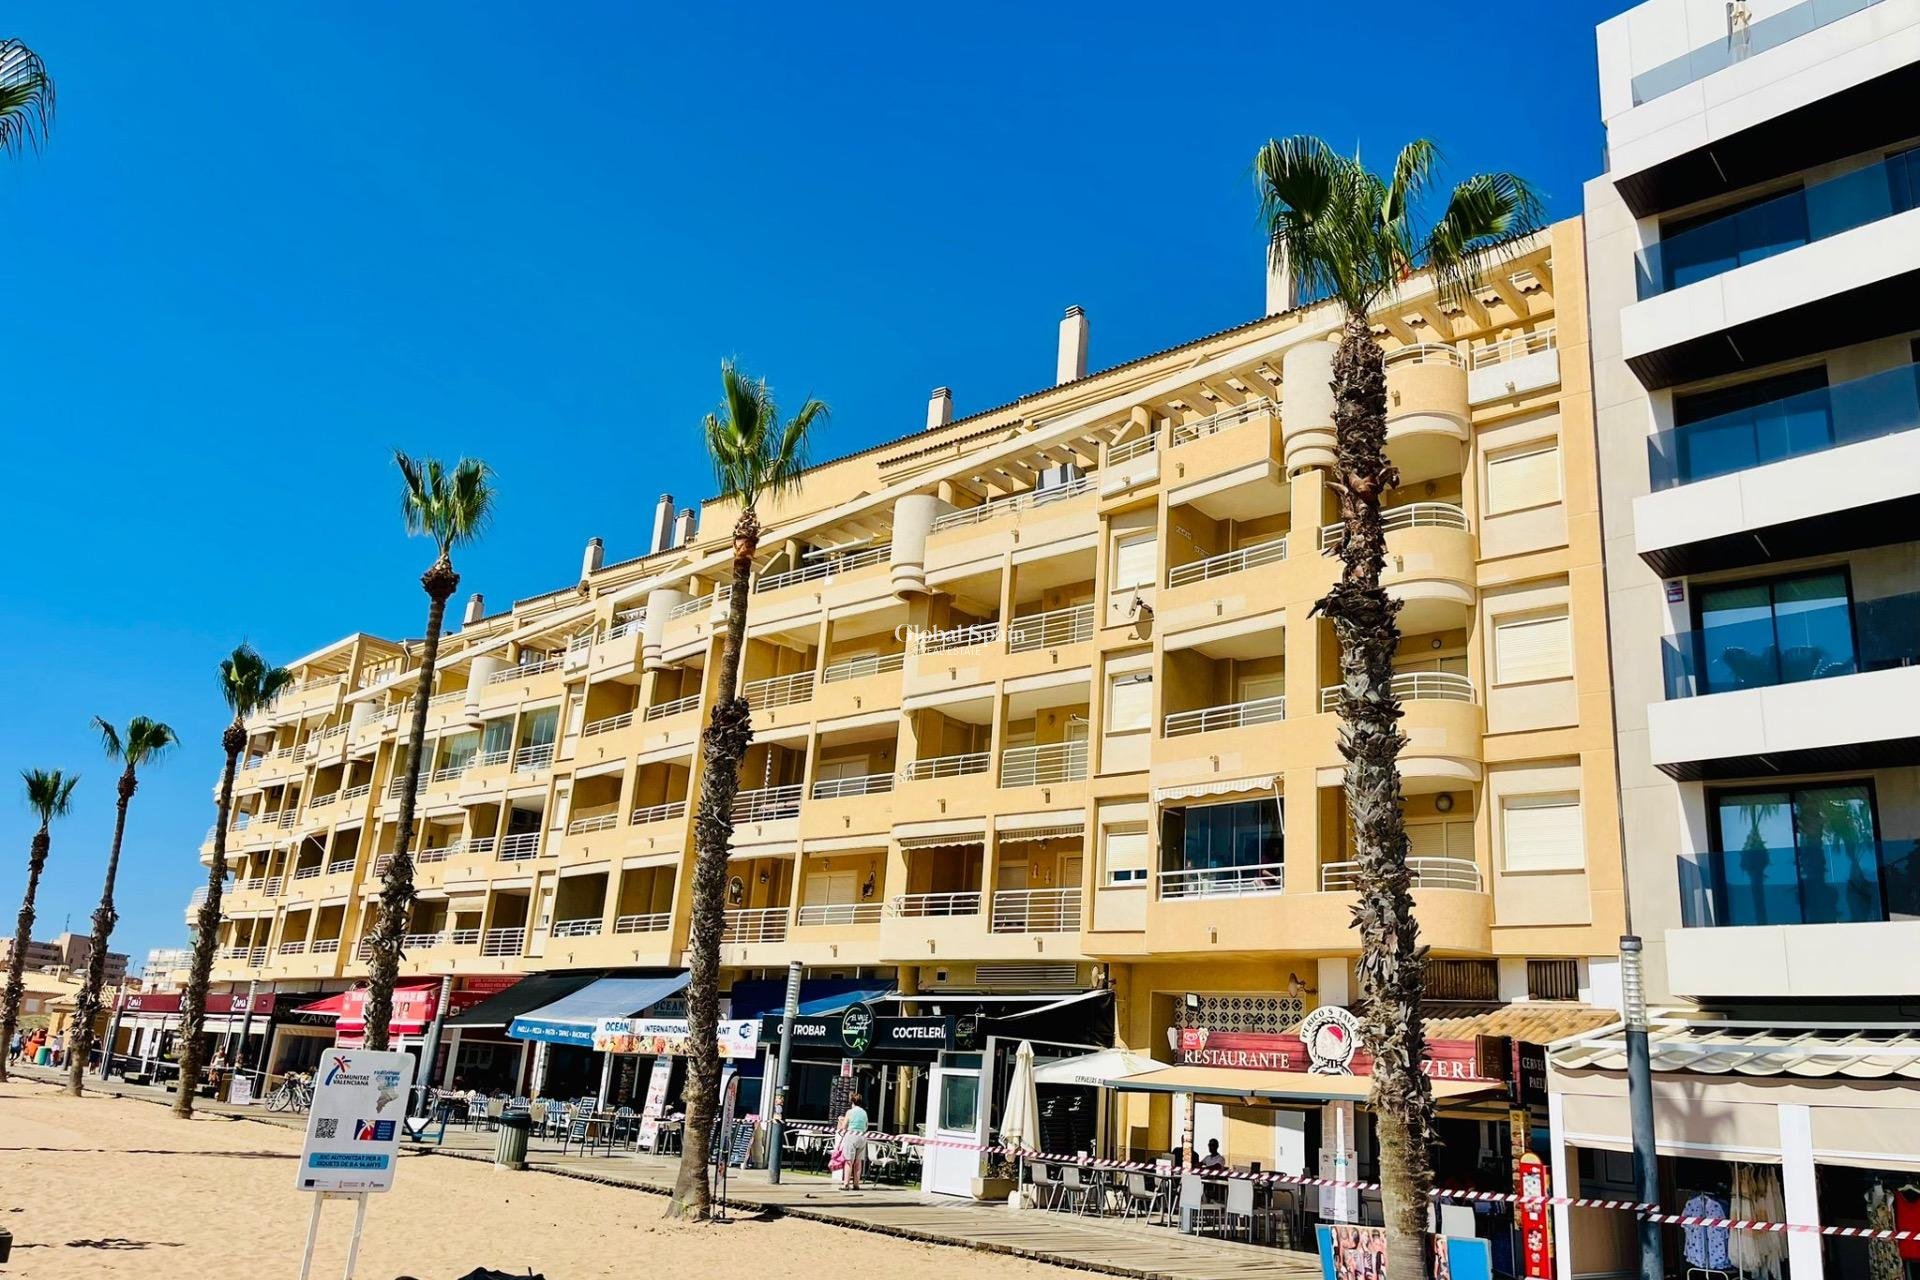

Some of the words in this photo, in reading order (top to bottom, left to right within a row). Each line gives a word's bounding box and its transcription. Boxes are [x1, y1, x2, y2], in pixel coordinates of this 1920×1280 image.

[653, 1001, 685, 1010] OCEAN
[605, 1022, 630, 1032] OCEAN
[644, 1025, 688, 1034] INTERNATIONAL
[777, 1024, 826, 1037] GTROBAR
[1302, 1010, 1325, 1038] PERICO
[1184, 1049, 1290, 1069] RESTAURANTE
[1521, 1056, 1545, 1071] CERVEC
[335, 1073, 370, 1081] COMUNITAT
